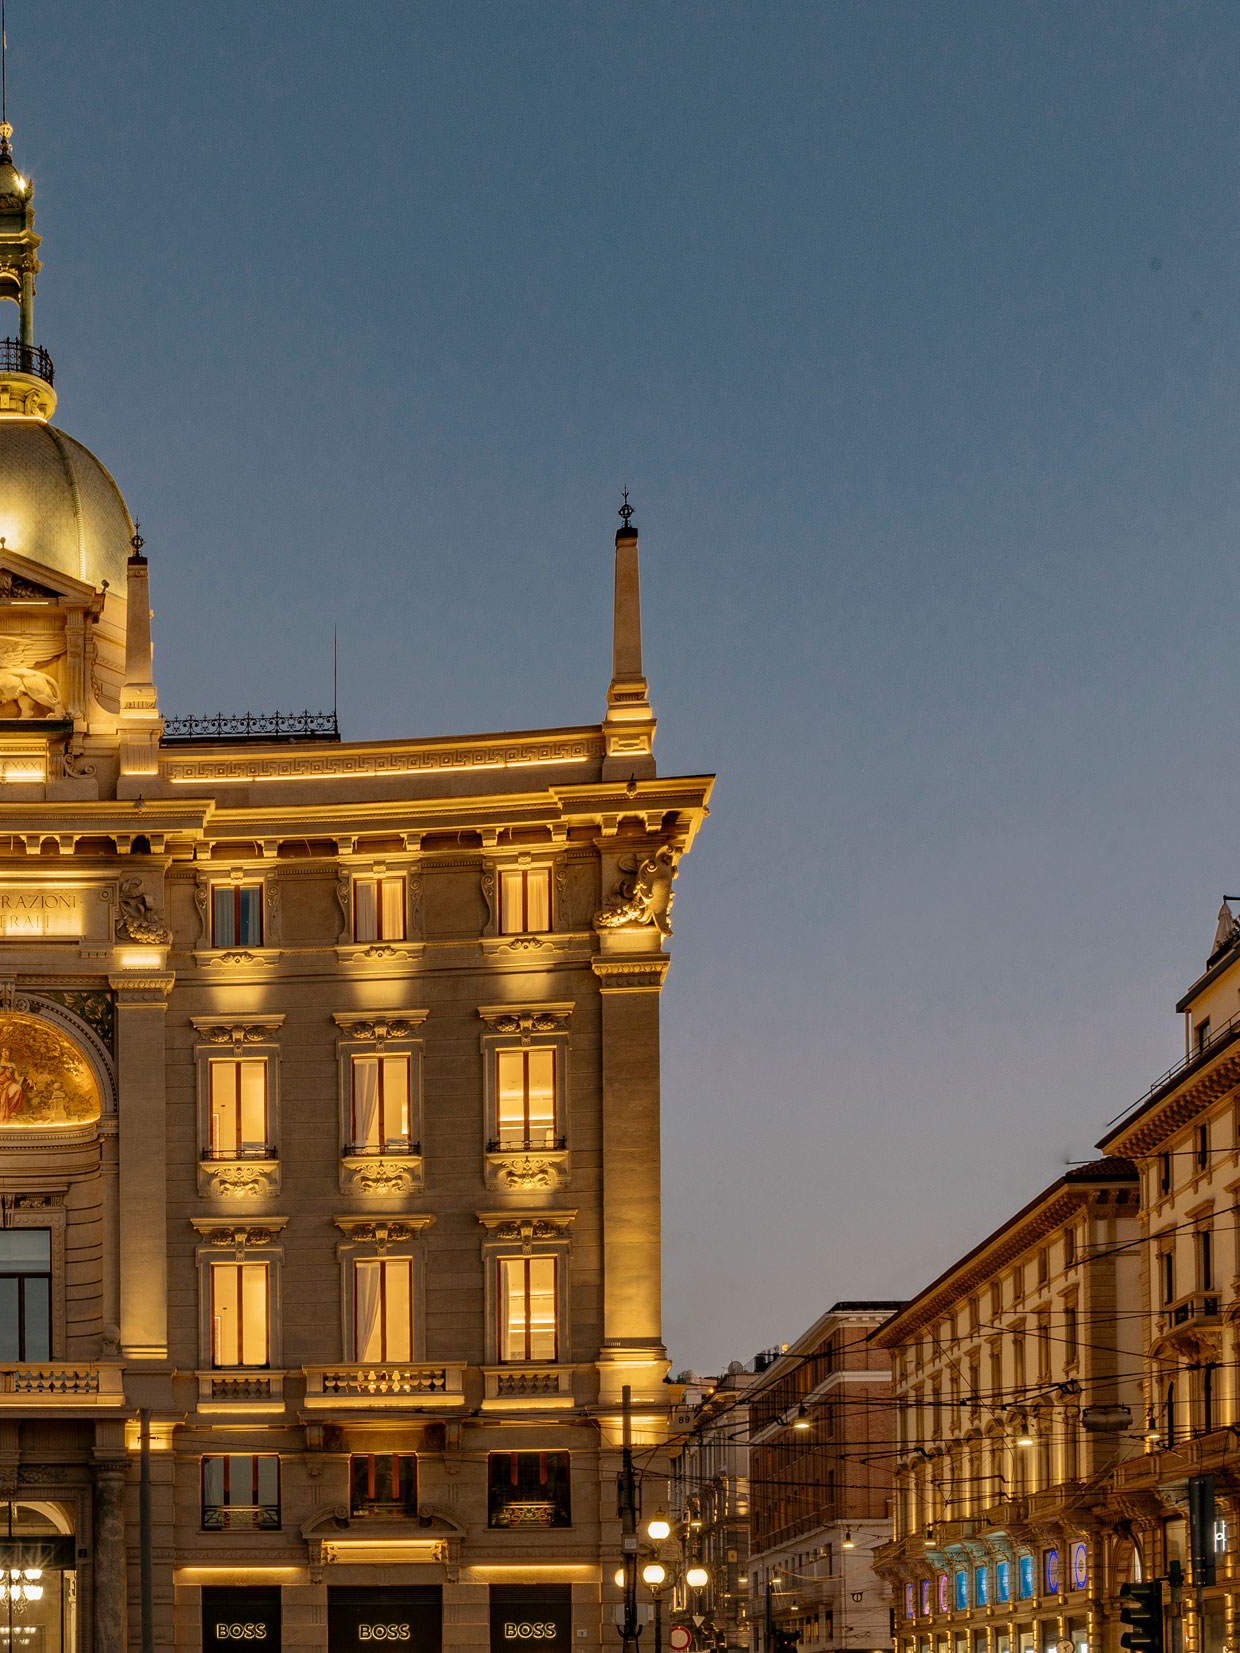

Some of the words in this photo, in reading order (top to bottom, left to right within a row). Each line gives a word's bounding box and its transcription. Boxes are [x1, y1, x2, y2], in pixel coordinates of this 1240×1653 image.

[678, 1415, 690, 1424] 89
[216, 1622, 267, 1639] BOSS
[359, 1623, 410, 1640] BOSS
[504, 1622, 556, 1639] BOSS
